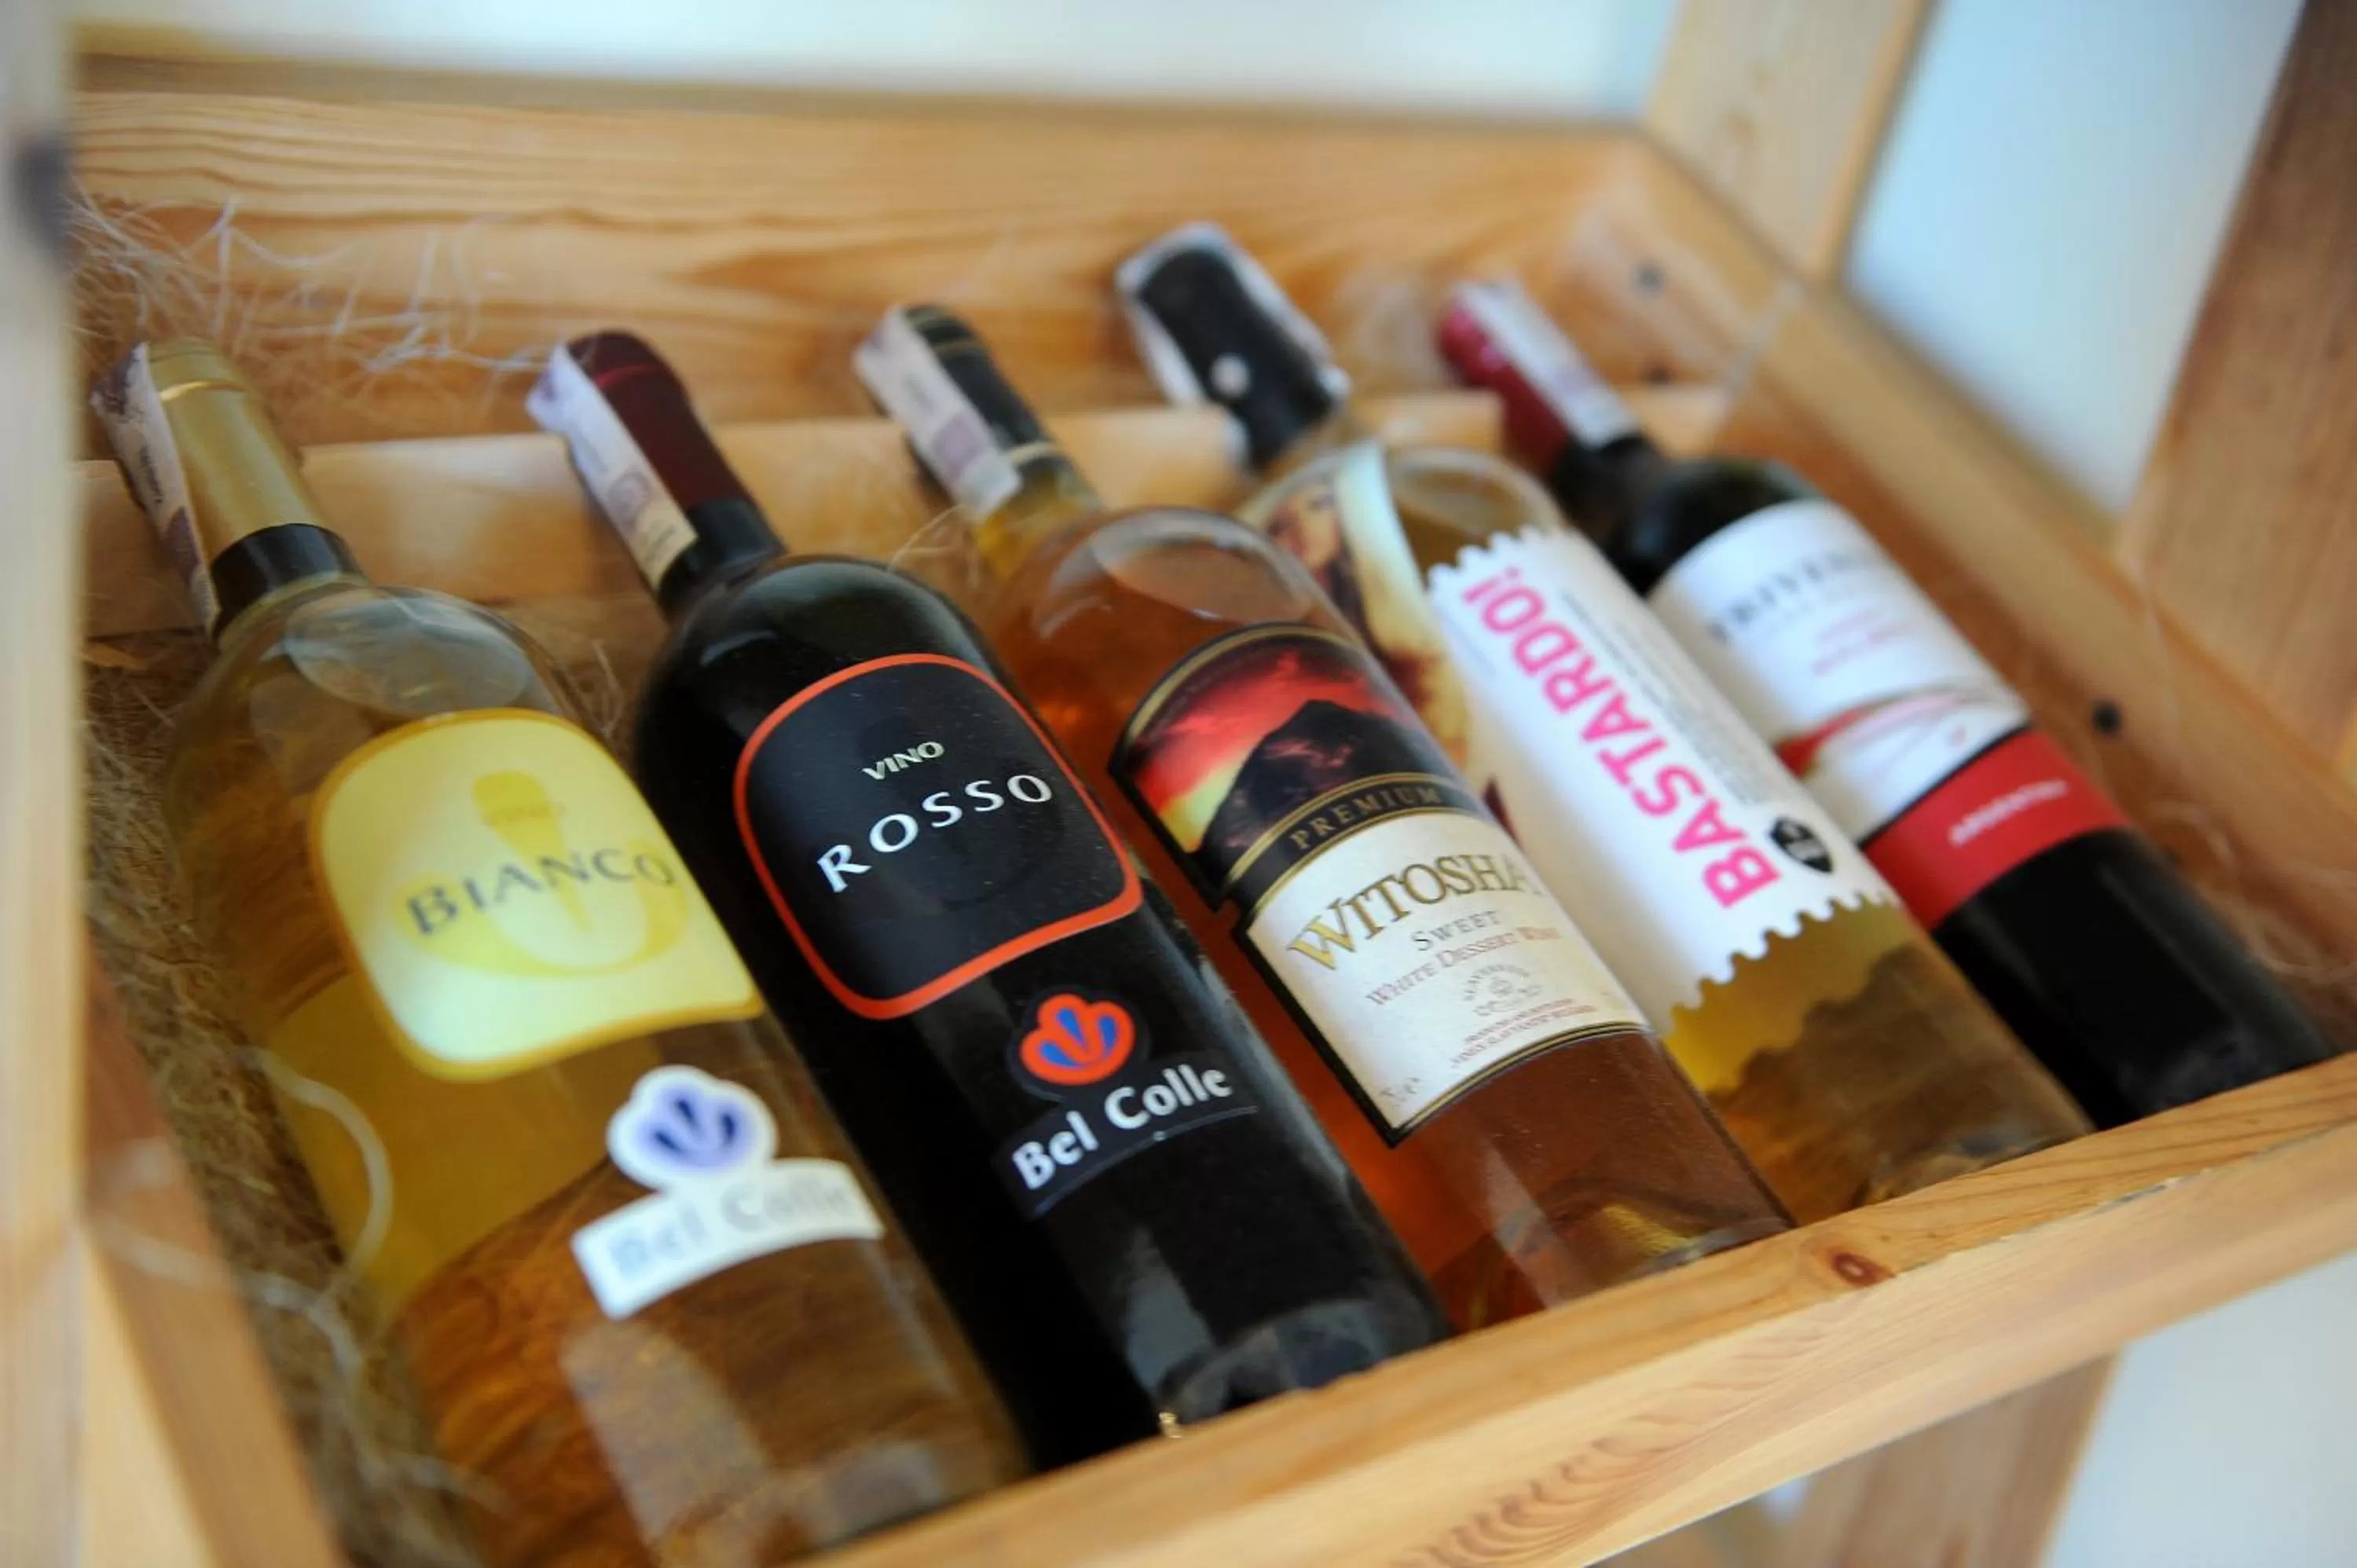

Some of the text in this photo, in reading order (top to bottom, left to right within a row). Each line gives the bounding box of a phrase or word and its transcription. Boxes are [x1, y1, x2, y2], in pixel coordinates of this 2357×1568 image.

[863, 739, 944, 780] VINO
[1461, 566, 1782, 909] BASTARDO!
[816, 774, 1052, 893] ROSSO
[1288, 786, 1443, 850] PREMIUM
[405, 848, 678, 936] BIANCO
[1285, 853, 1545, 971] WITOSHA
[1410, 910, 1501, 952] SWEET
[1012, 1063, 1234, 1190] Bel Colle
